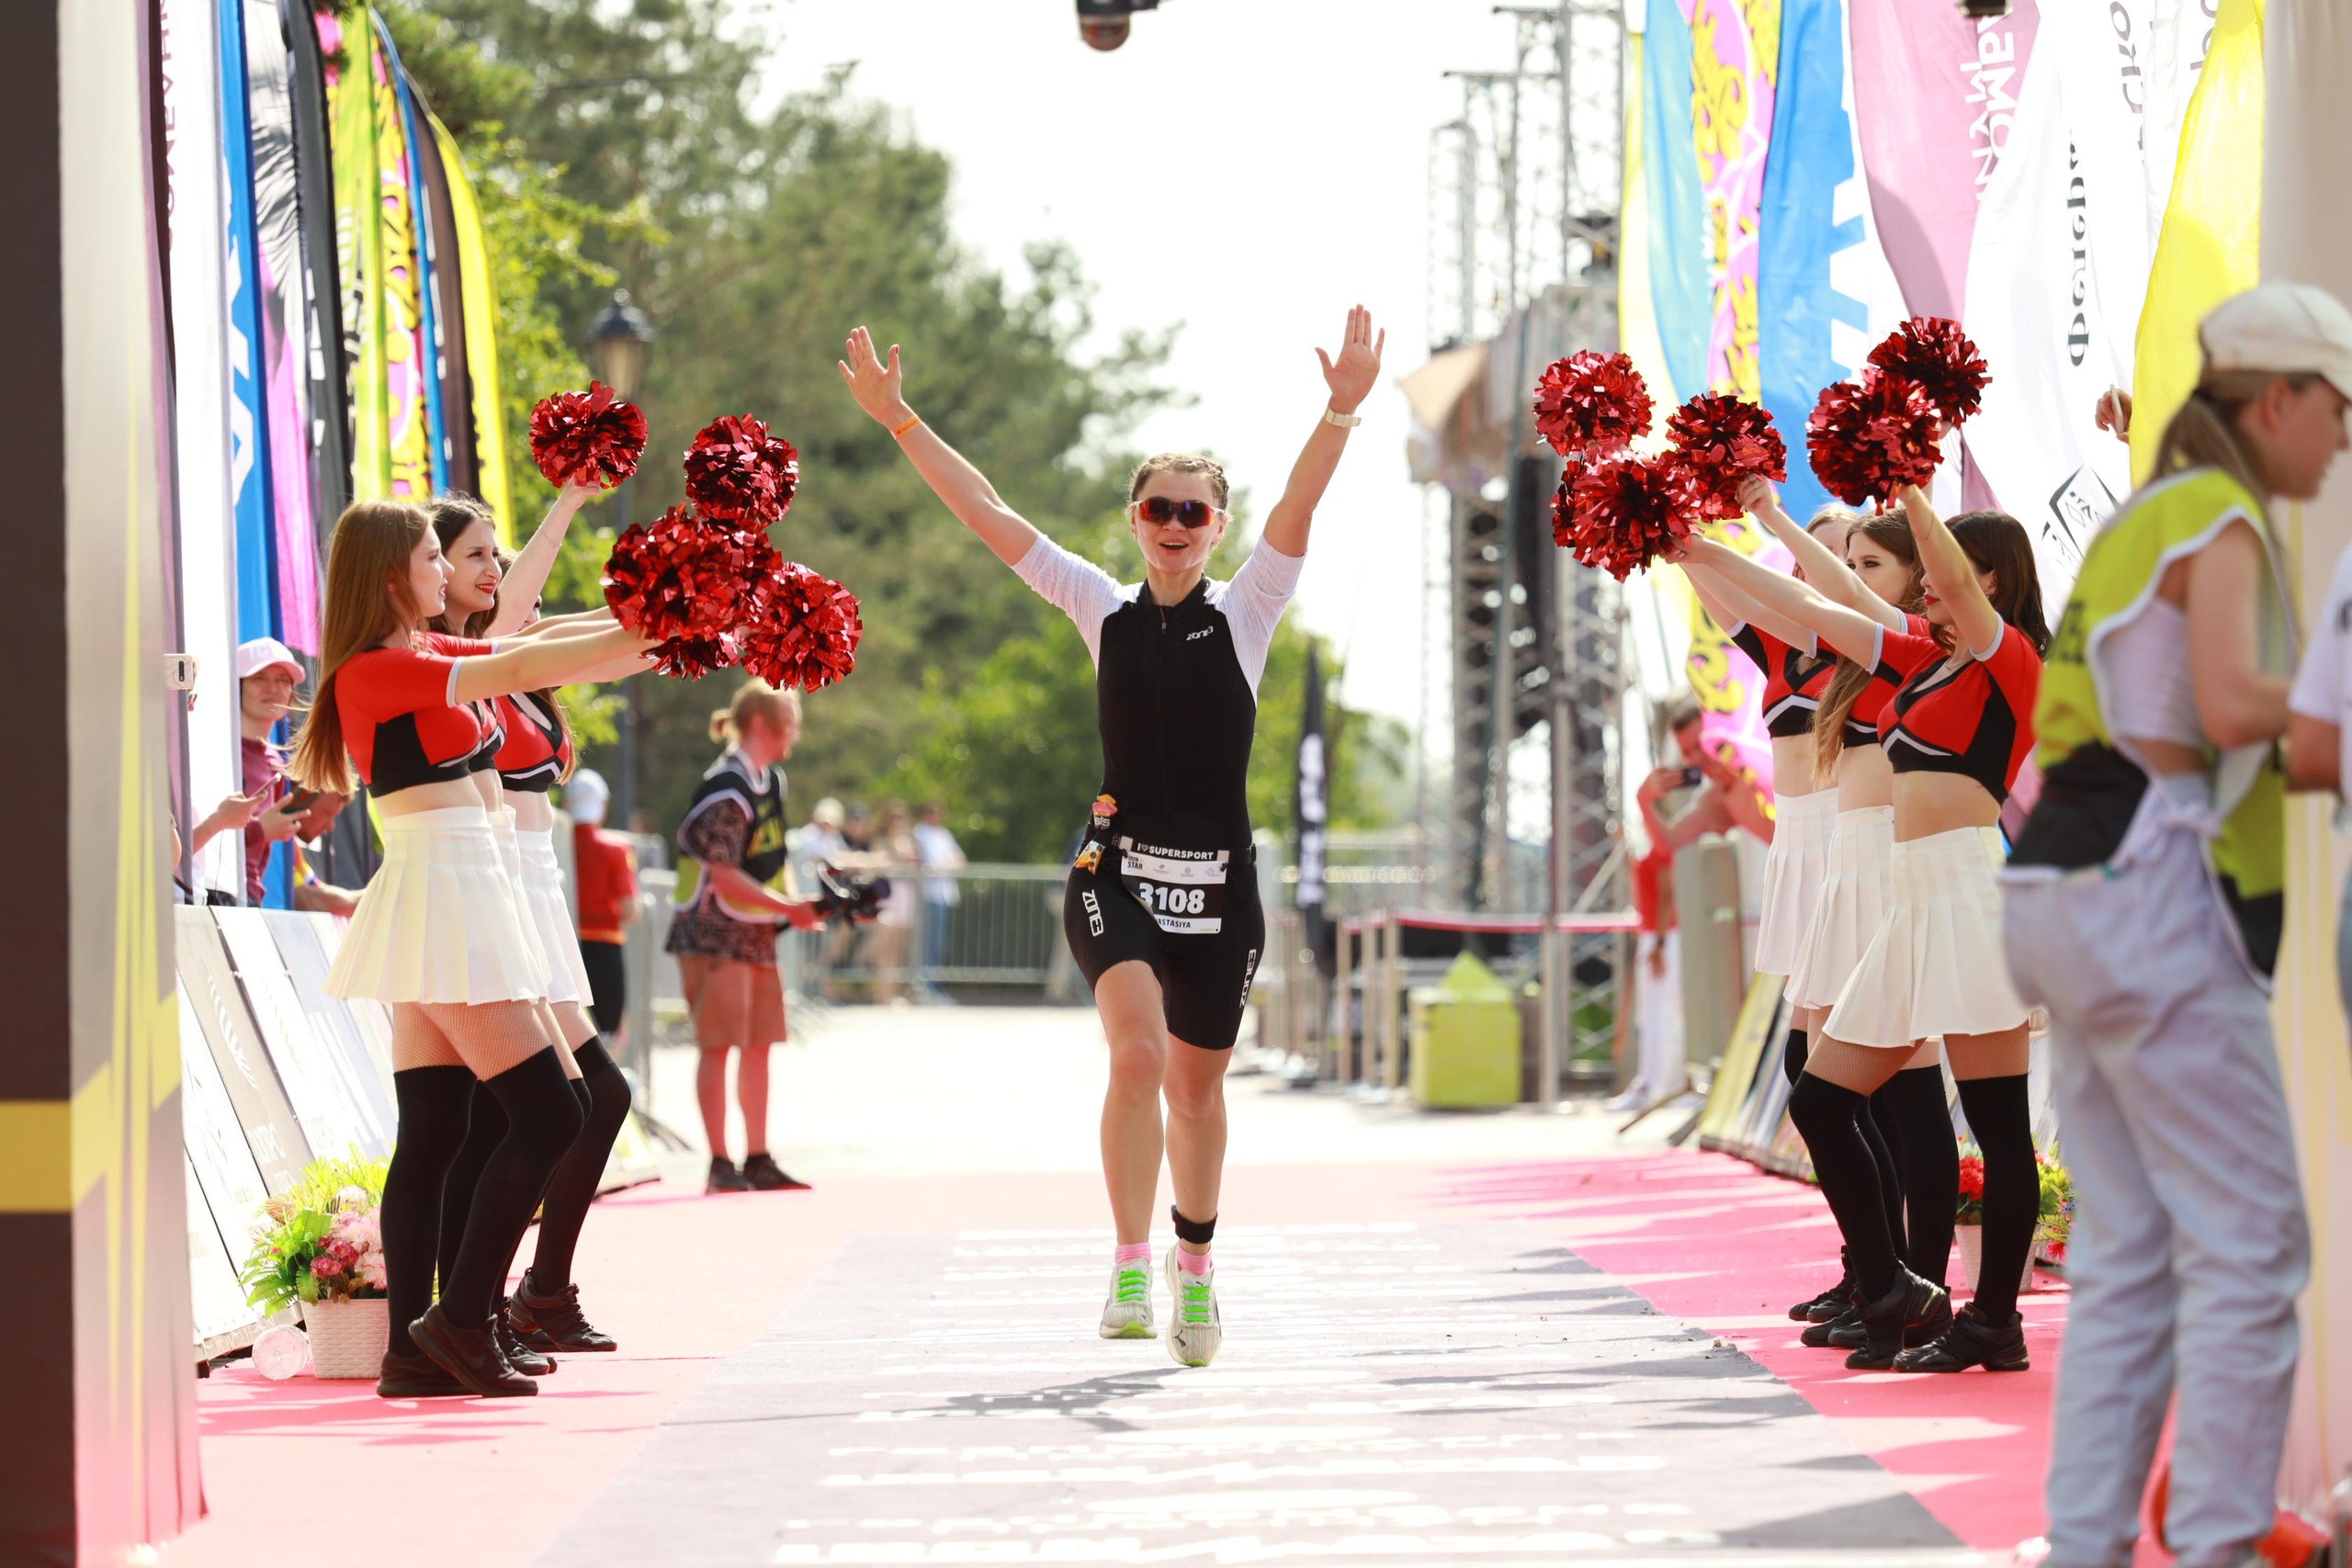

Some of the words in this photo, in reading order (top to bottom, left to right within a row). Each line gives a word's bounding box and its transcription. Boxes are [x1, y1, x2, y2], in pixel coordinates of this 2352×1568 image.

[1137, 842, 1141, 852] I
[1148, 845, 1214, 860] SUPERSPORT
[1127, 862, 1143, 870] STAR
[1139, 883, 1205, 914] 3108
